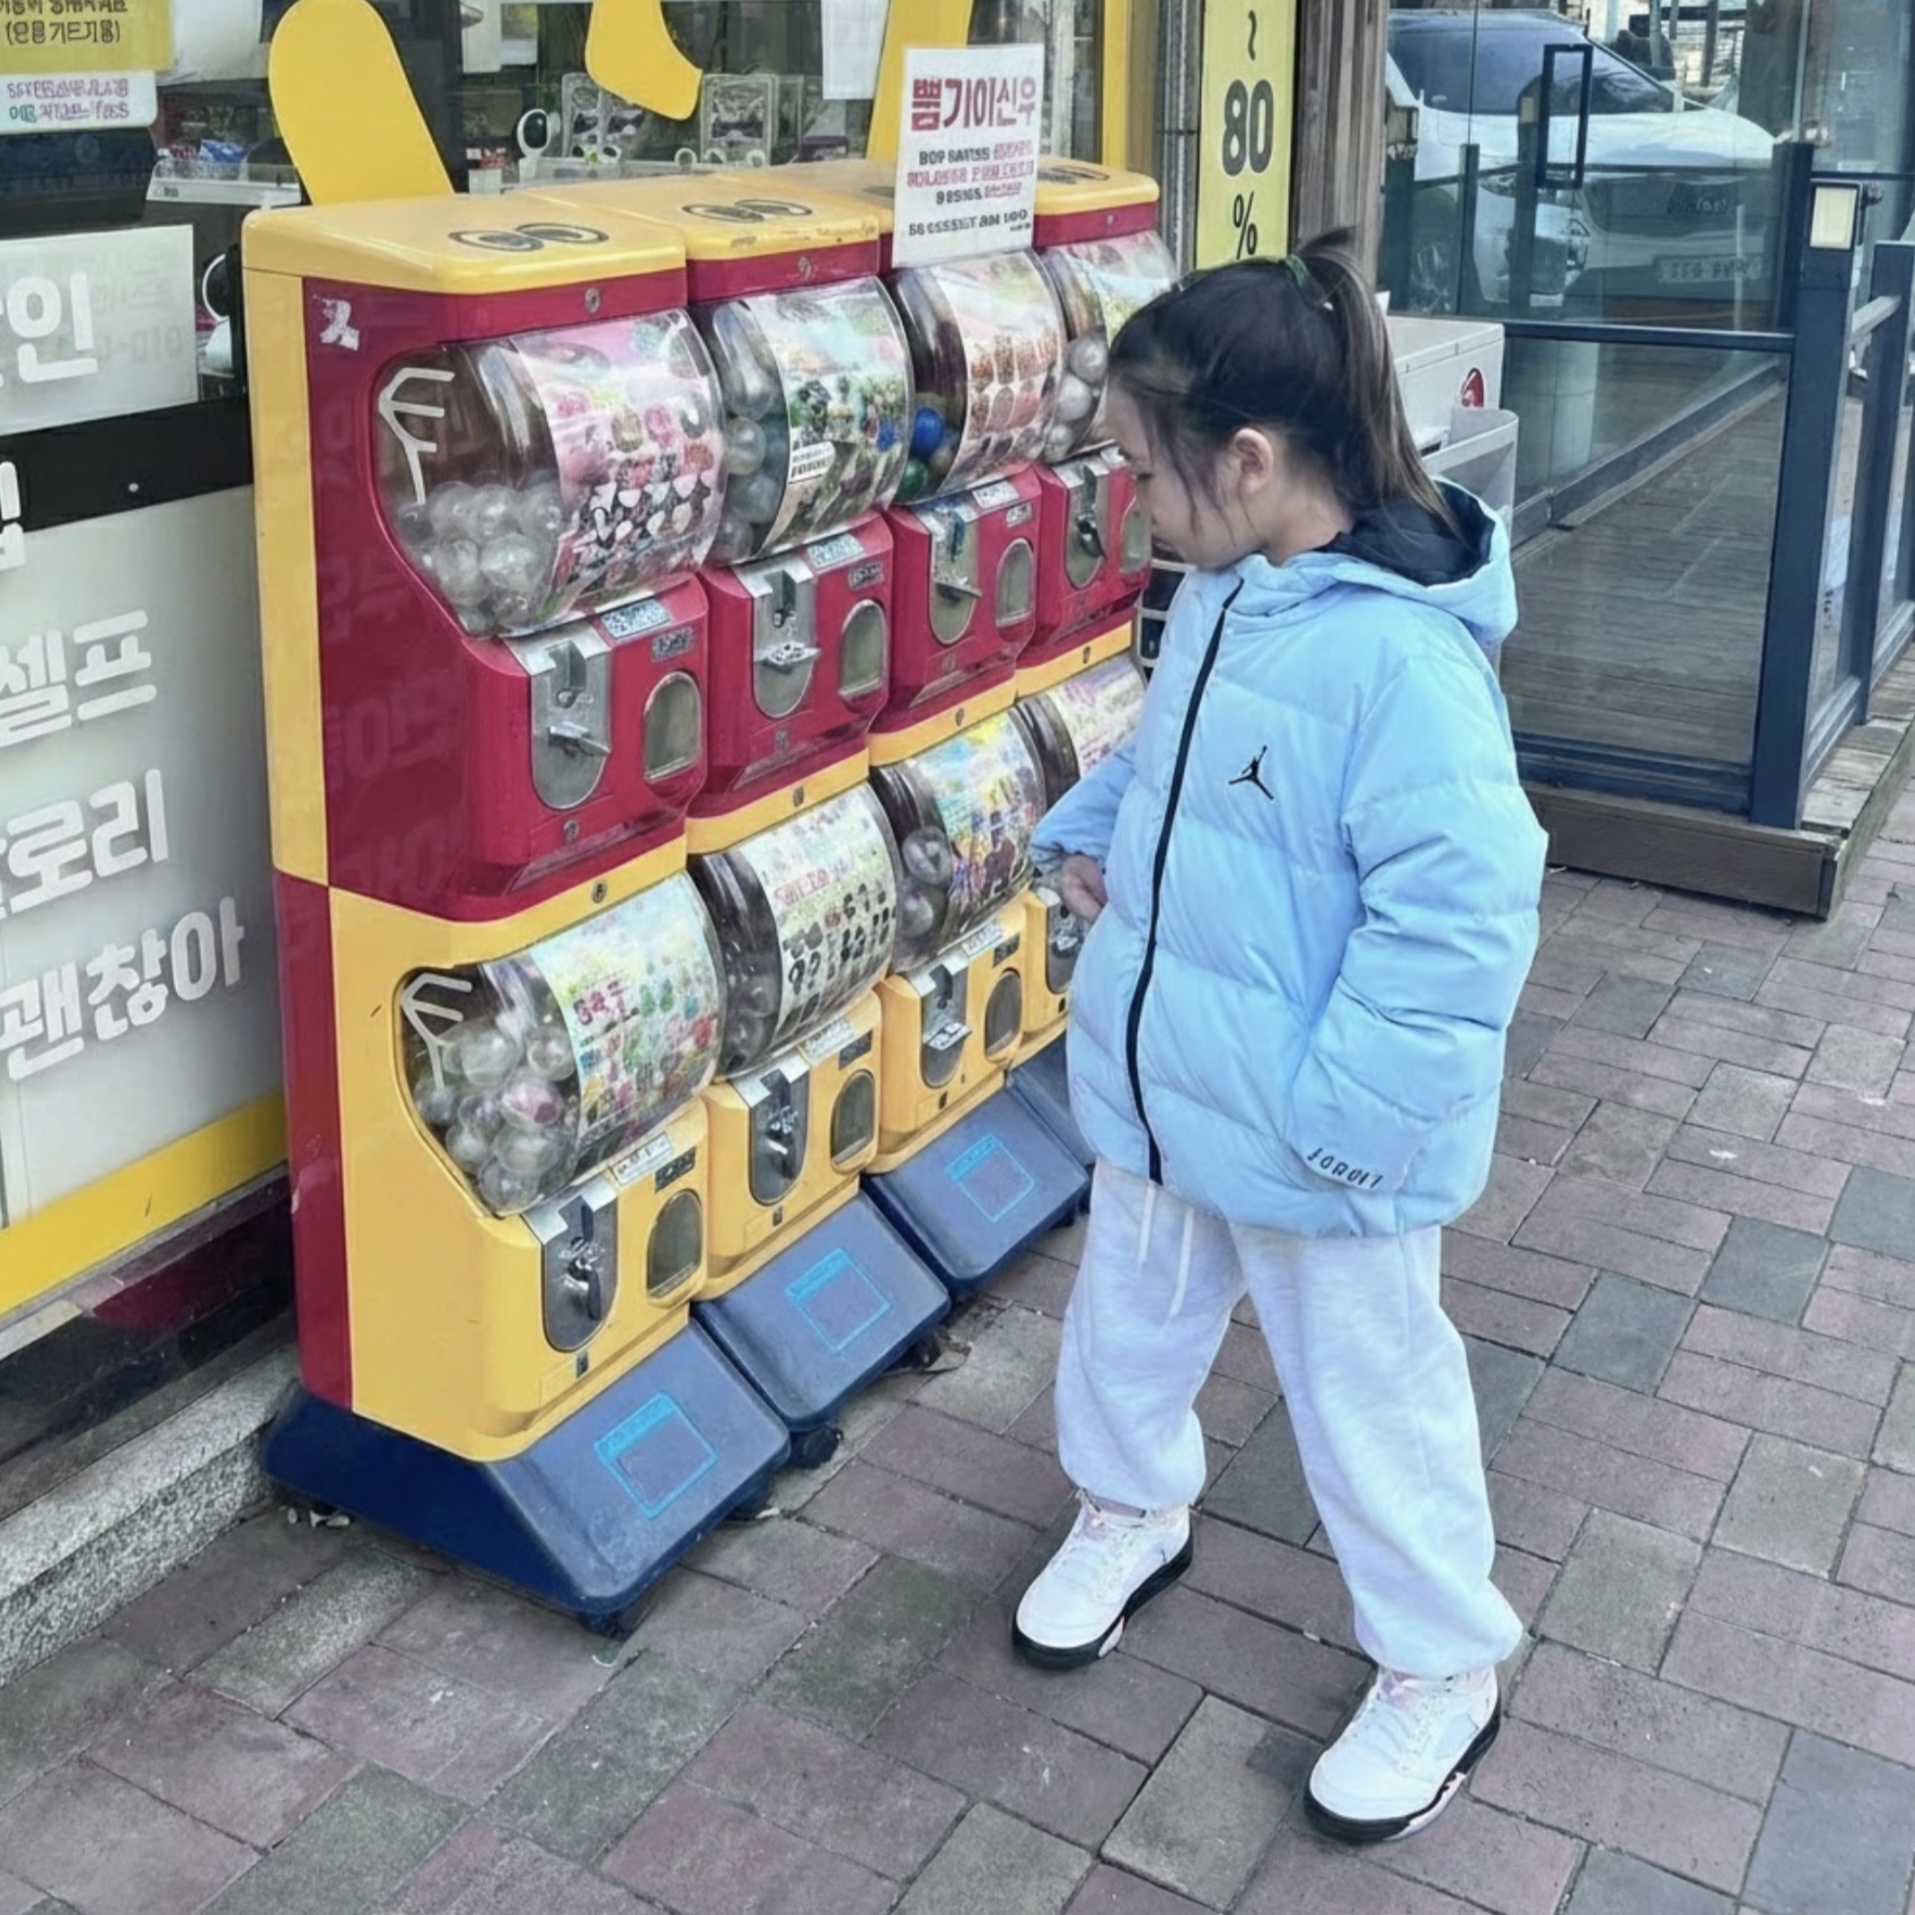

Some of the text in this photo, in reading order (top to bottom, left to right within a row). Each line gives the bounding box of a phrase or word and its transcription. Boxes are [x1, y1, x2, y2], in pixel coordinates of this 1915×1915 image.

[1222, 79, 1274, 176] 80
[1233, 191, 1258, 260] %
[0, 270, 98, 383] 인
[0, 769, 168, 920] 로리
[0, 896, 245, 1081] 괜찮아
